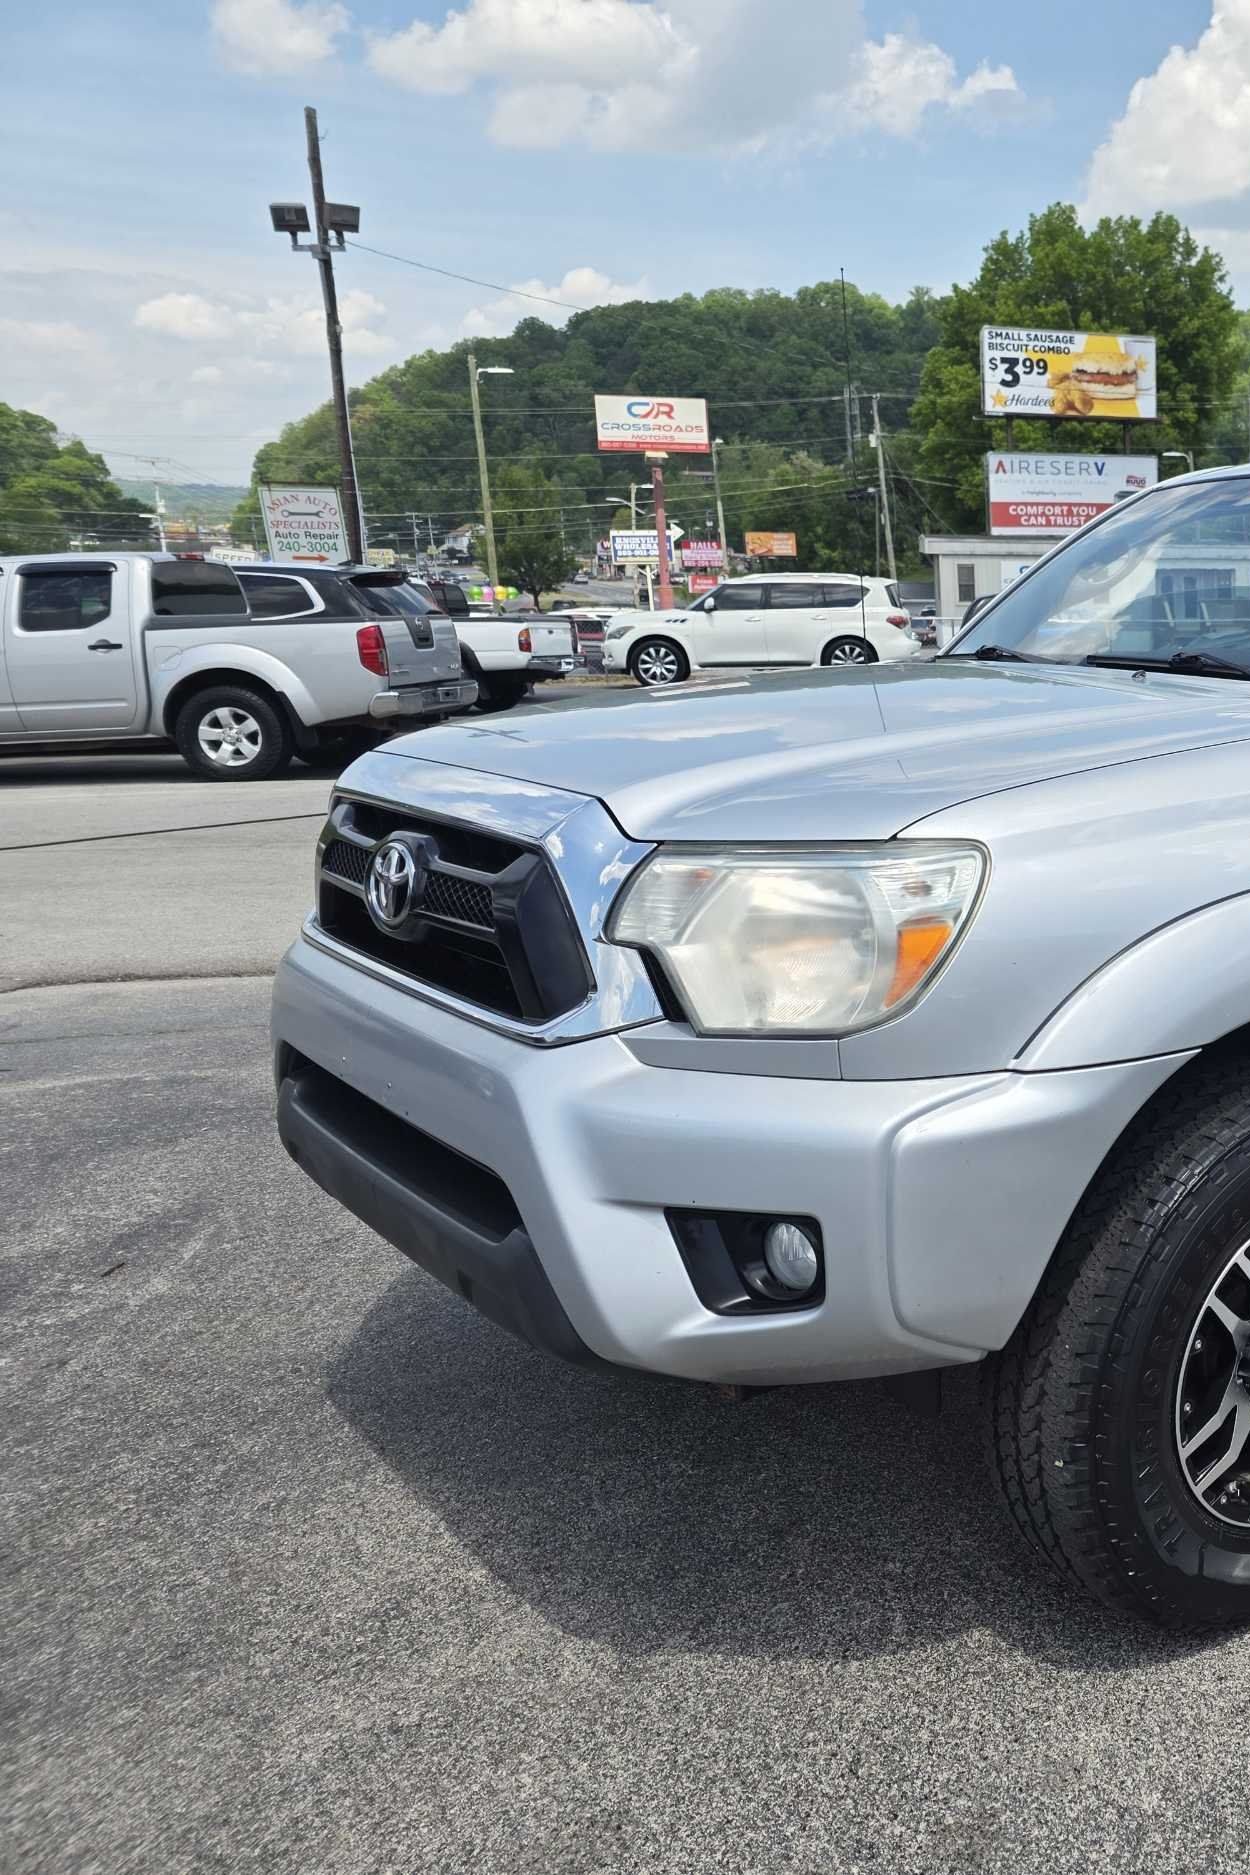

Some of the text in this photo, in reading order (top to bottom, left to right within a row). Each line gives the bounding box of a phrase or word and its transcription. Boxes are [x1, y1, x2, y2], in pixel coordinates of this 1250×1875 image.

[987, 330, 1075, 345] SMALL SAUSAGE
[988, 341, 1071, 355] BISCUIT COMBO
[601, 422, 704, 433] CROSSROADS
[631, 433, 675, 441] MOTORS
[267, 494, 338, 517] ASIAN AUTO
[1008, 505, 1097, 516] COMFORT YOU
[270, 520, 339, 530] SPECIALISTS
[1020, 516, 1086, 526] CAN TRUST
[274, 530, 339, 541] Auto Repair
[279, 541, 338, 552] 240-3004
[690, 541, 718, 549] HALLS
